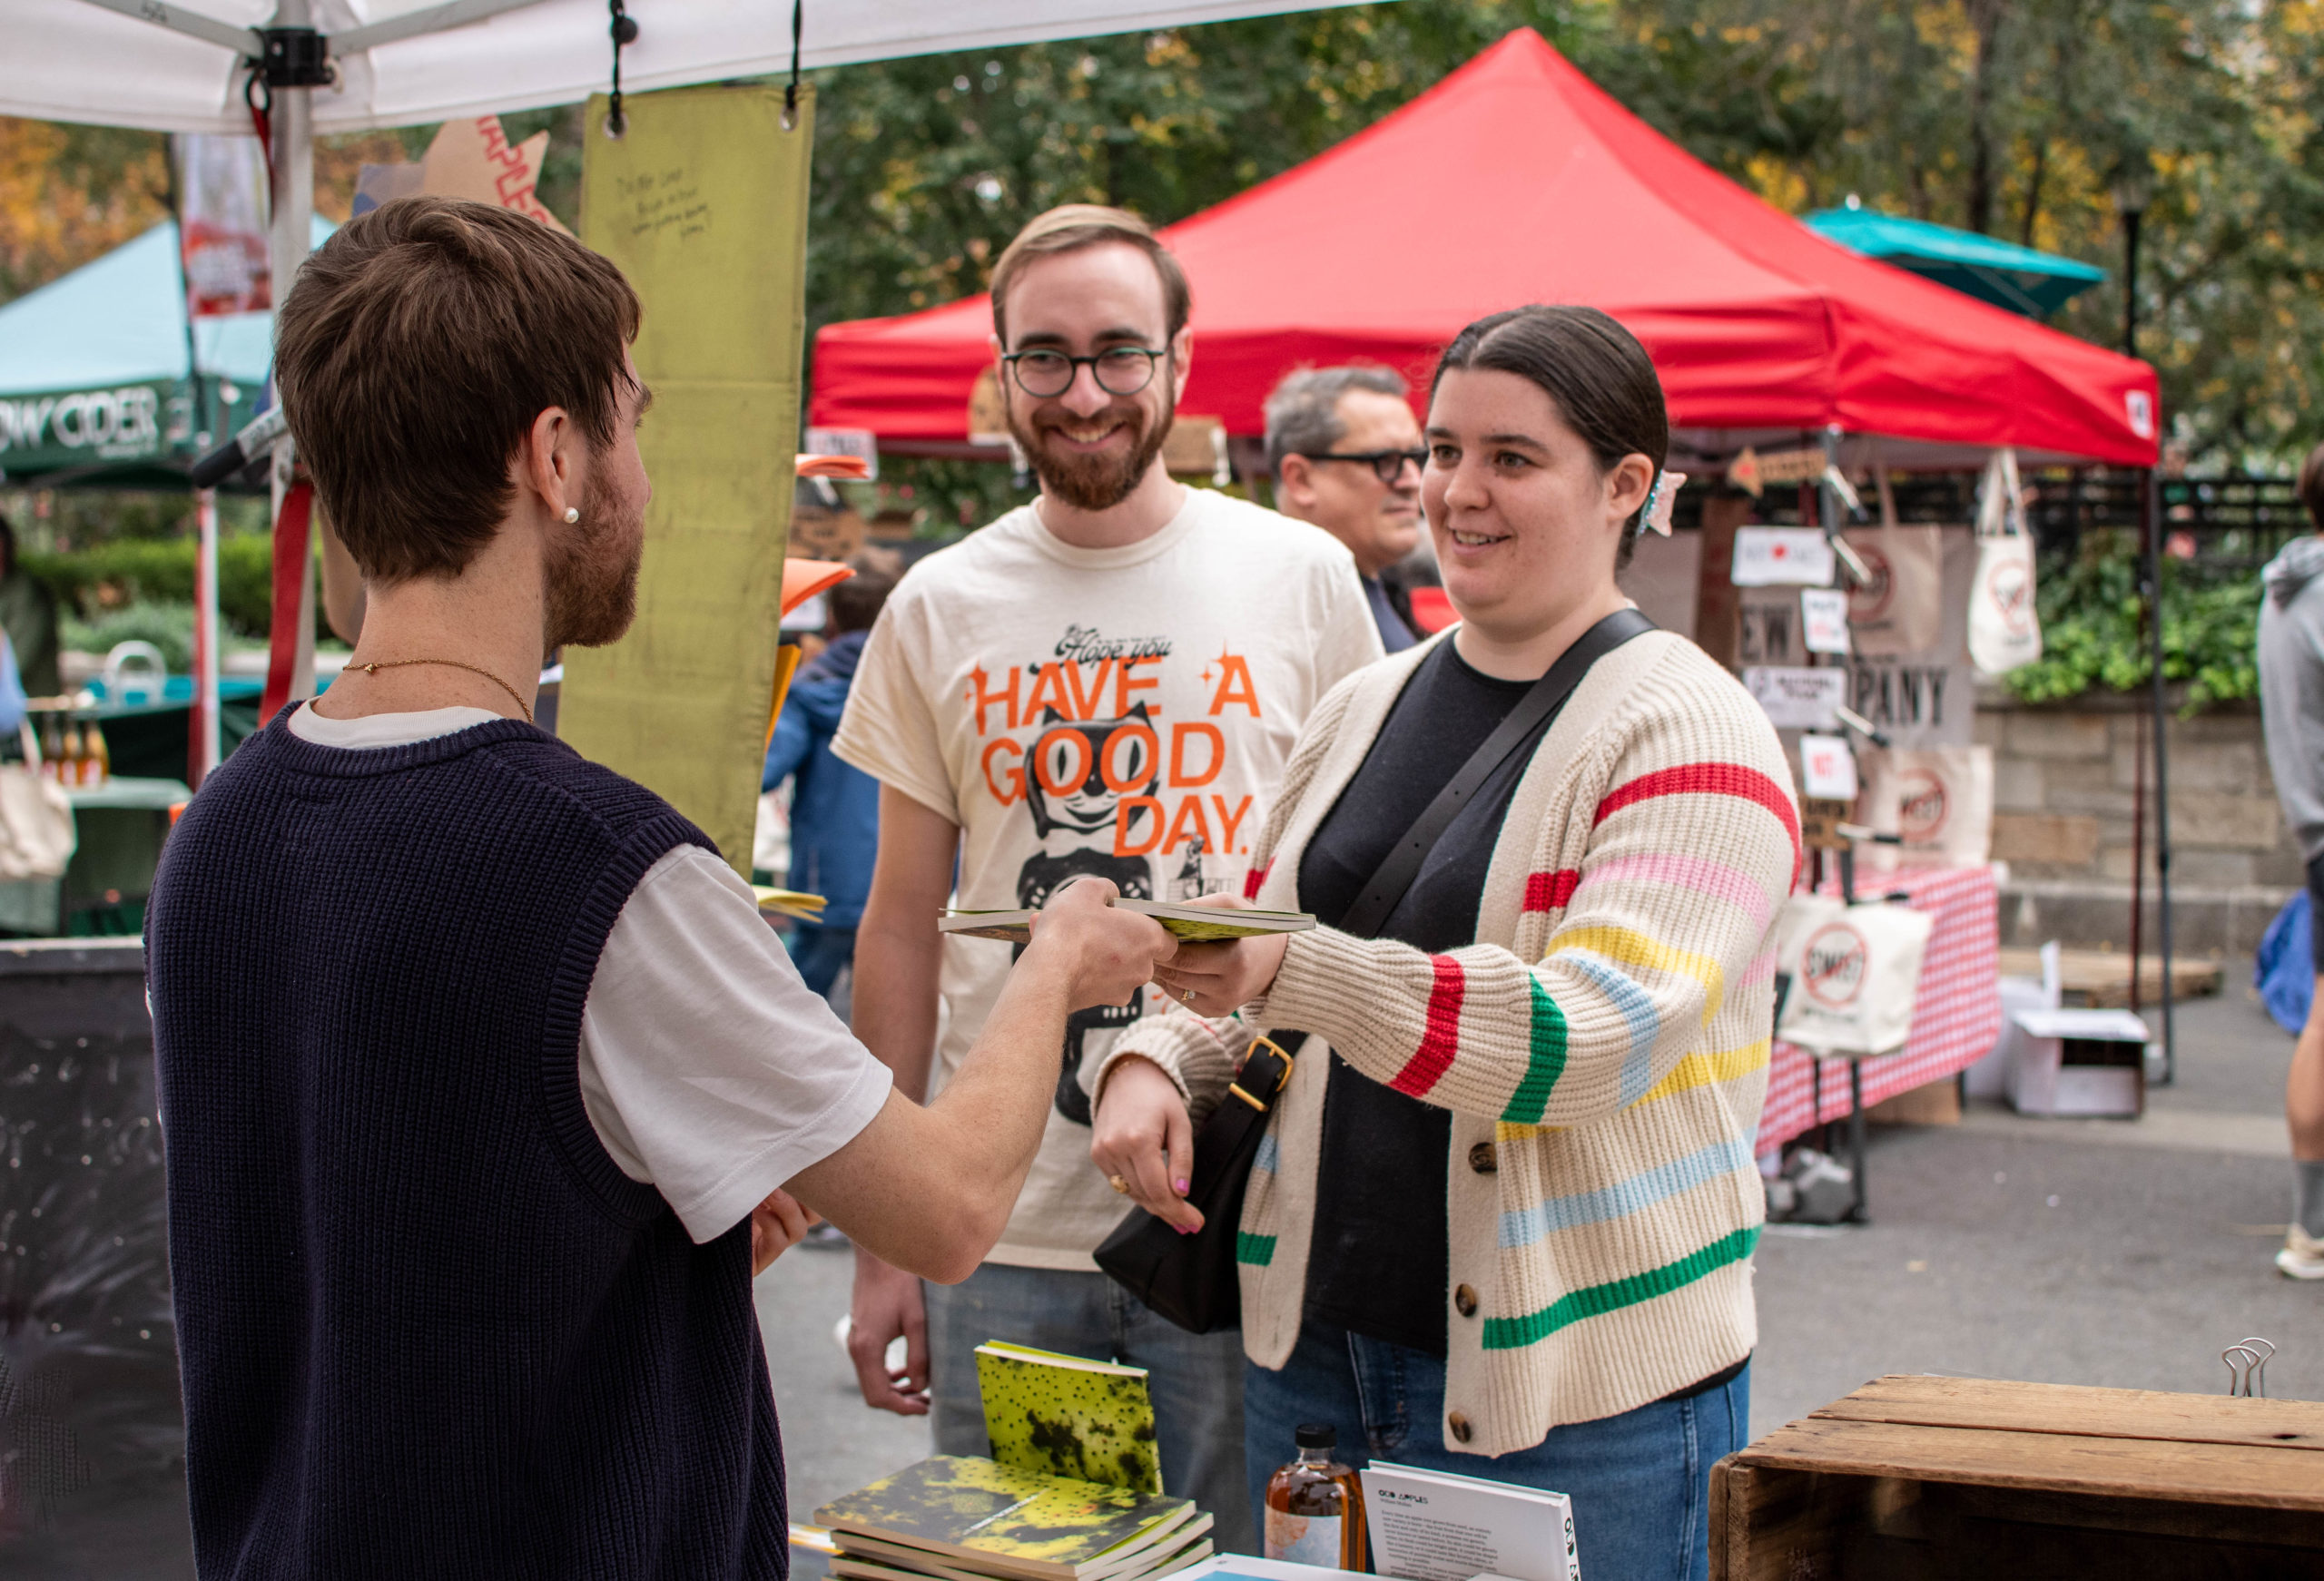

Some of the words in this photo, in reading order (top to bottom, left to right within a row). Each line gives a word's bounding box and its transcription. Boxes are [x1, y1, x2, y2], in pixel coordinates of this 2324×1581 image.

[1029, 625, 1124, 673] Hope
[1124, 640, 1173, 670] you
[974, 655, 1161, 736] HAVE
[1207, 655, 1262, 717] A
[1846, 666, 1948, 727] PANY
[981, 722, 1226, 807] GOOD
[1112, 794, 1254, 858] DAY.
